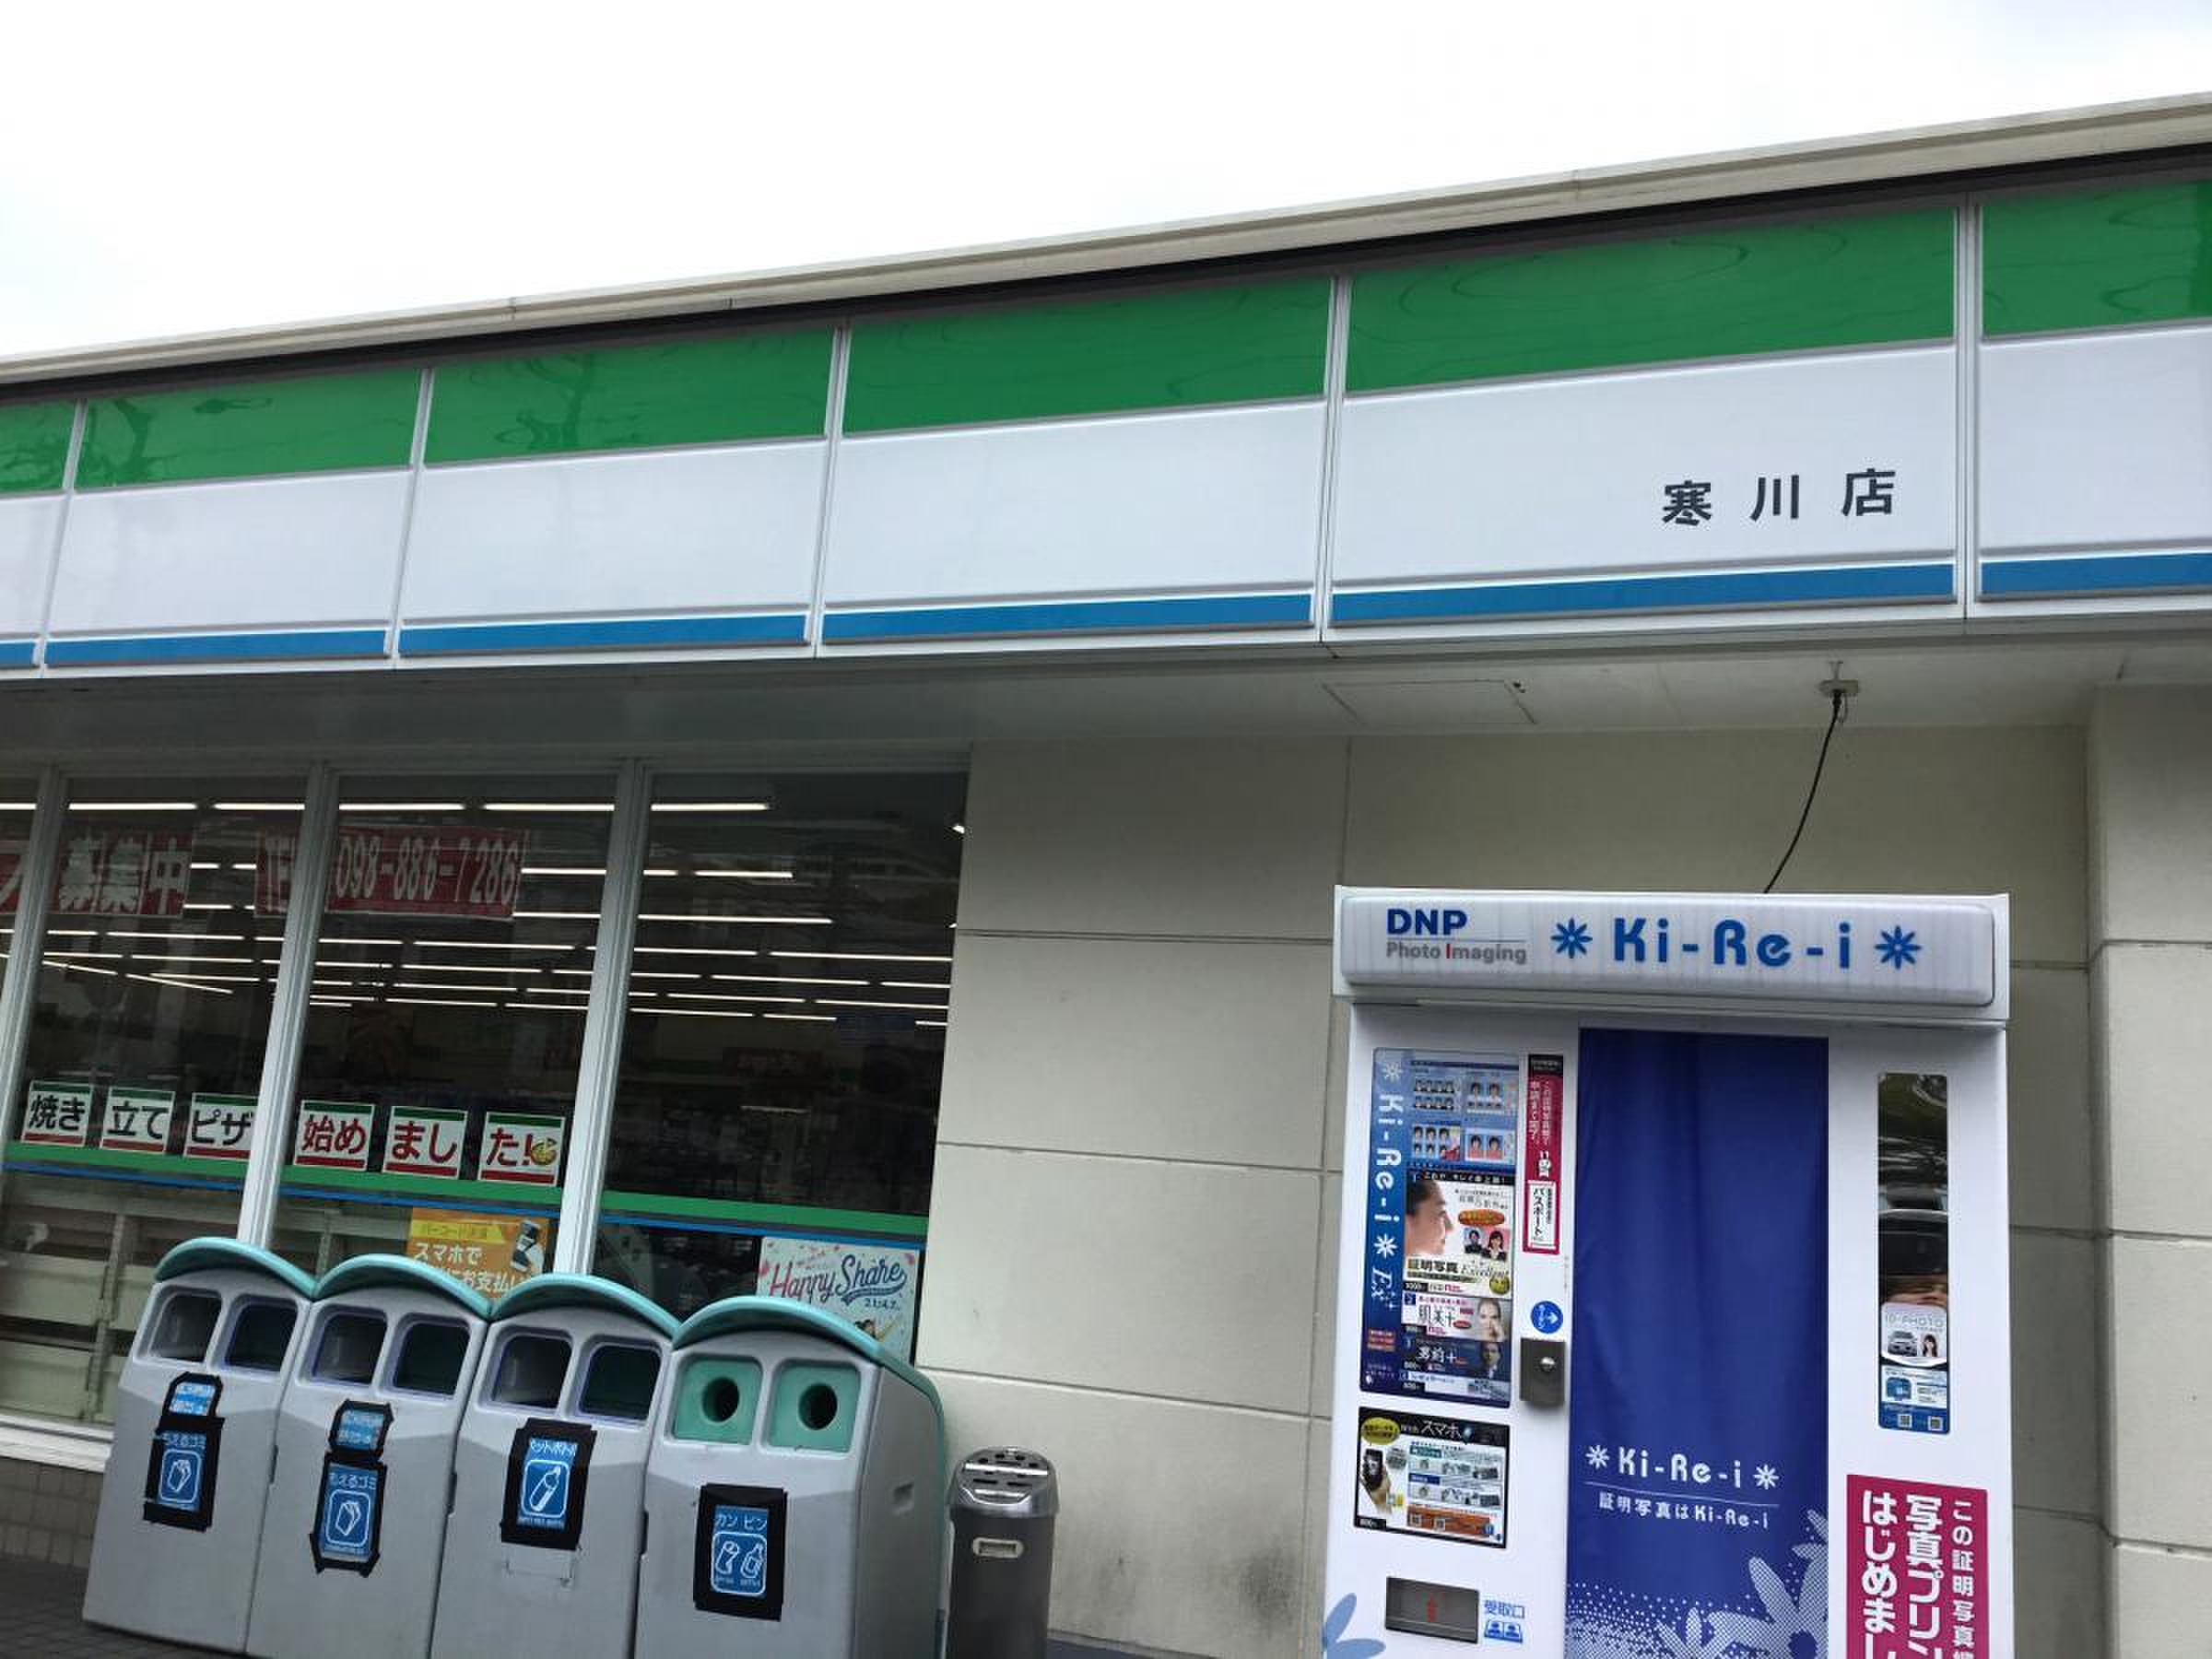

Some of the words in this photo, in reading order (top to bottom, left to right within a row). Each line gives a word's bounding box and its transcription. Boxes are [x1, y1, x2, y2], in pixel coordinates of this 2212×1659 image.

[1662, 467, 1896, 526] 寒川店
[59, 836, 192, 915] 募集中
[1386, 908, 1468, 935] DNP
[1385, 942, 1441, 960] Photo
[1445, 943, 1528, 965] Imaging
[1613, 917, 1853, 969] Ki-Re-i
[29, 1094, 86, 1131] 焼き
[107, 1100, 170, 1139] 立て
[191, 1109, 255, 1147] ピザ
[301, 1113, 368, 1155] 始め
[392, 1120, 459, 1164] まし
[413, 1242, 482, 1265] スマホで
[769, 1261, 834, 1303] Happy
[835, 1254, 908, 1296] Share
[1422, 1420, 1462, 1440] スマホ
[1618, 1446, 1742, 1488] Ki-Re-i
[1484, 1600, 1525, 1618] 受取口
